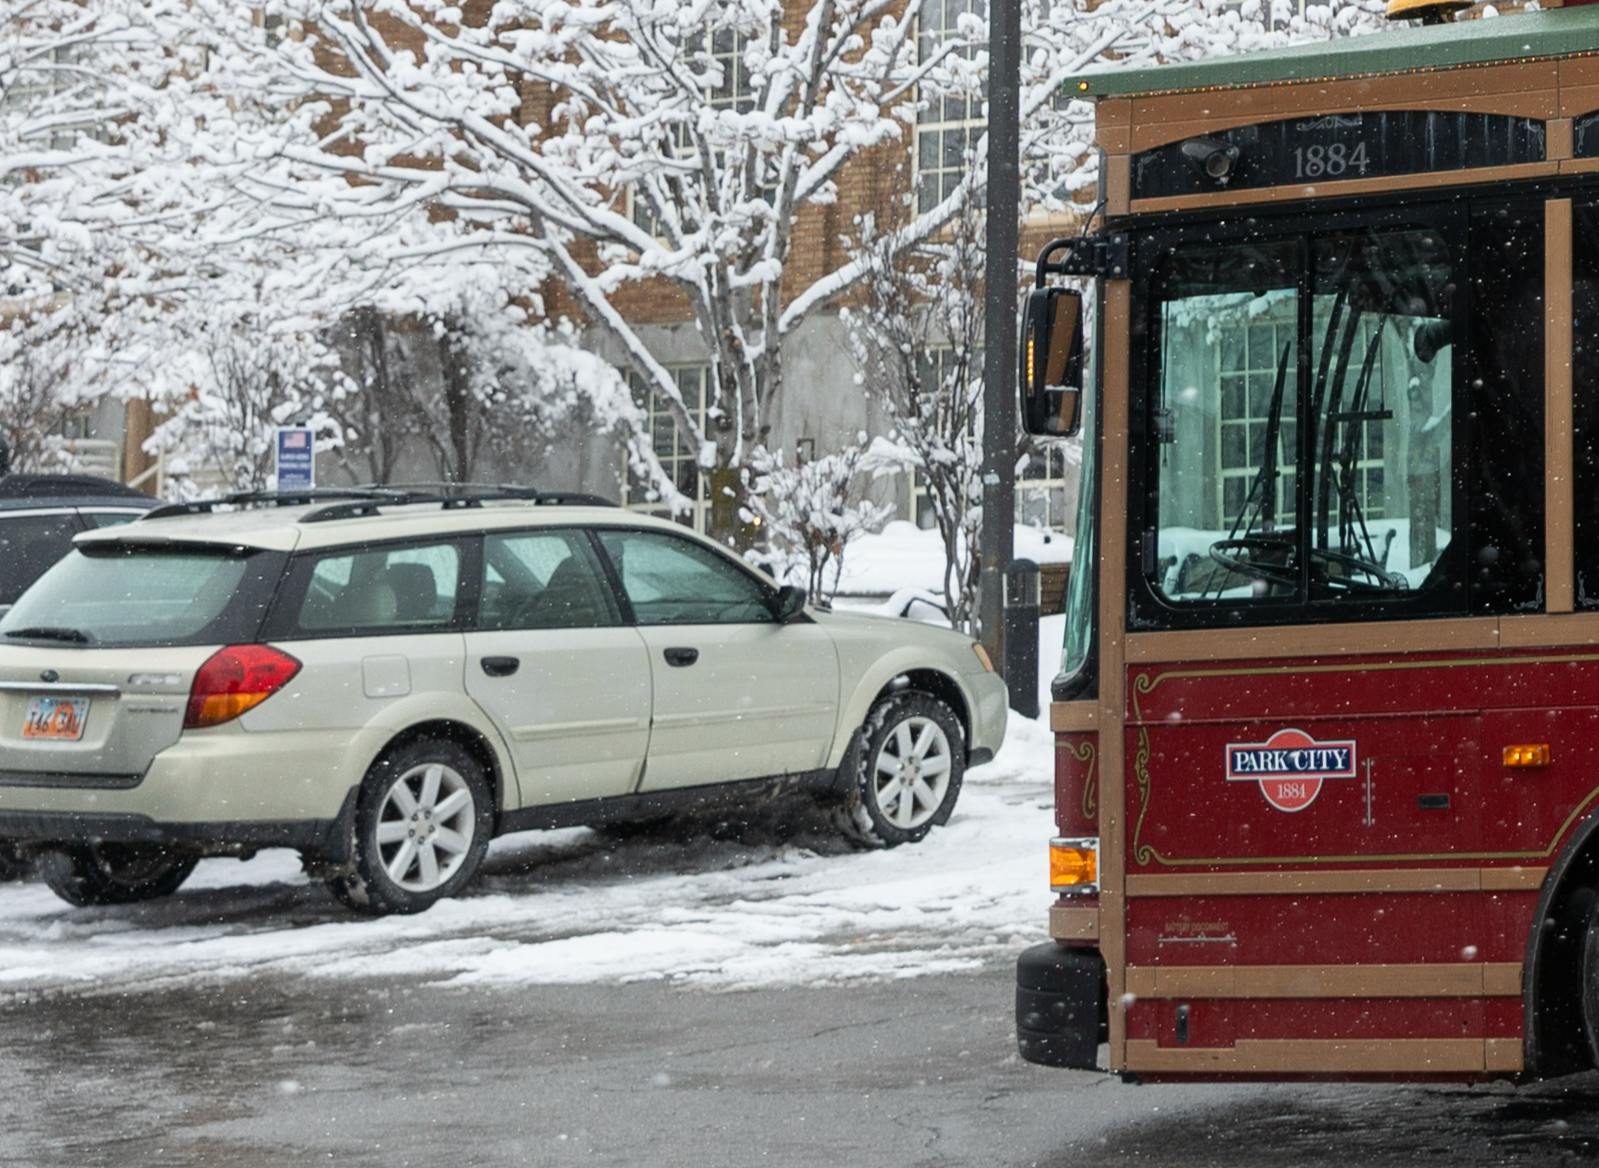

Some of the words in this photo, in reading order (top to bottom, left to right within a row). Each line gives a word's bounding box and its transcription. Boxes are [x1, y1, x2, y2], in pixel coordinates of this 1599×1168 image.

[1294, 142, 1369, 178] 1884
[1234, 750, 1289, 772] PARK
[1294, 748, 1348, 770] CITY
[1277, 783, 1306, 799] 1884
